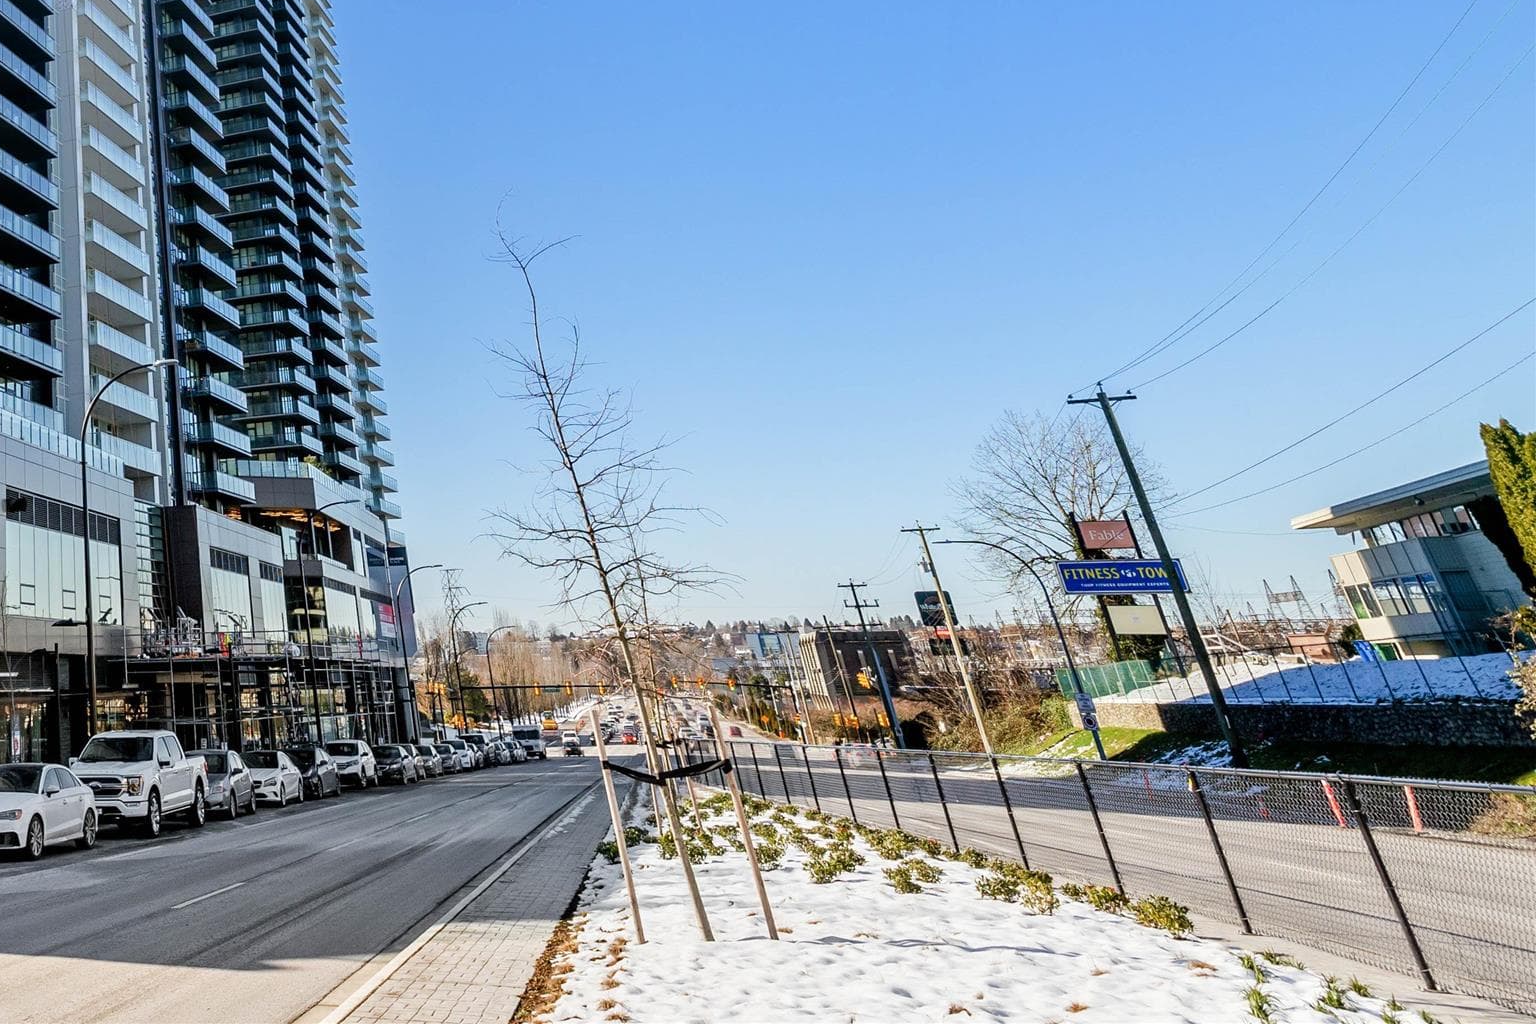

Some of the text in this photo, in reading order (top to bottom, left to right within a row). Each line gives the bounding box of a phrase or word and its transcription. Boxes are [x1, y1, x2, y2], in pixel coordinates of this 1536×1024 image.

[1088, 529, 1124, 541] Fable
[1063, 566, 1168, 580] FITNESS TOW
